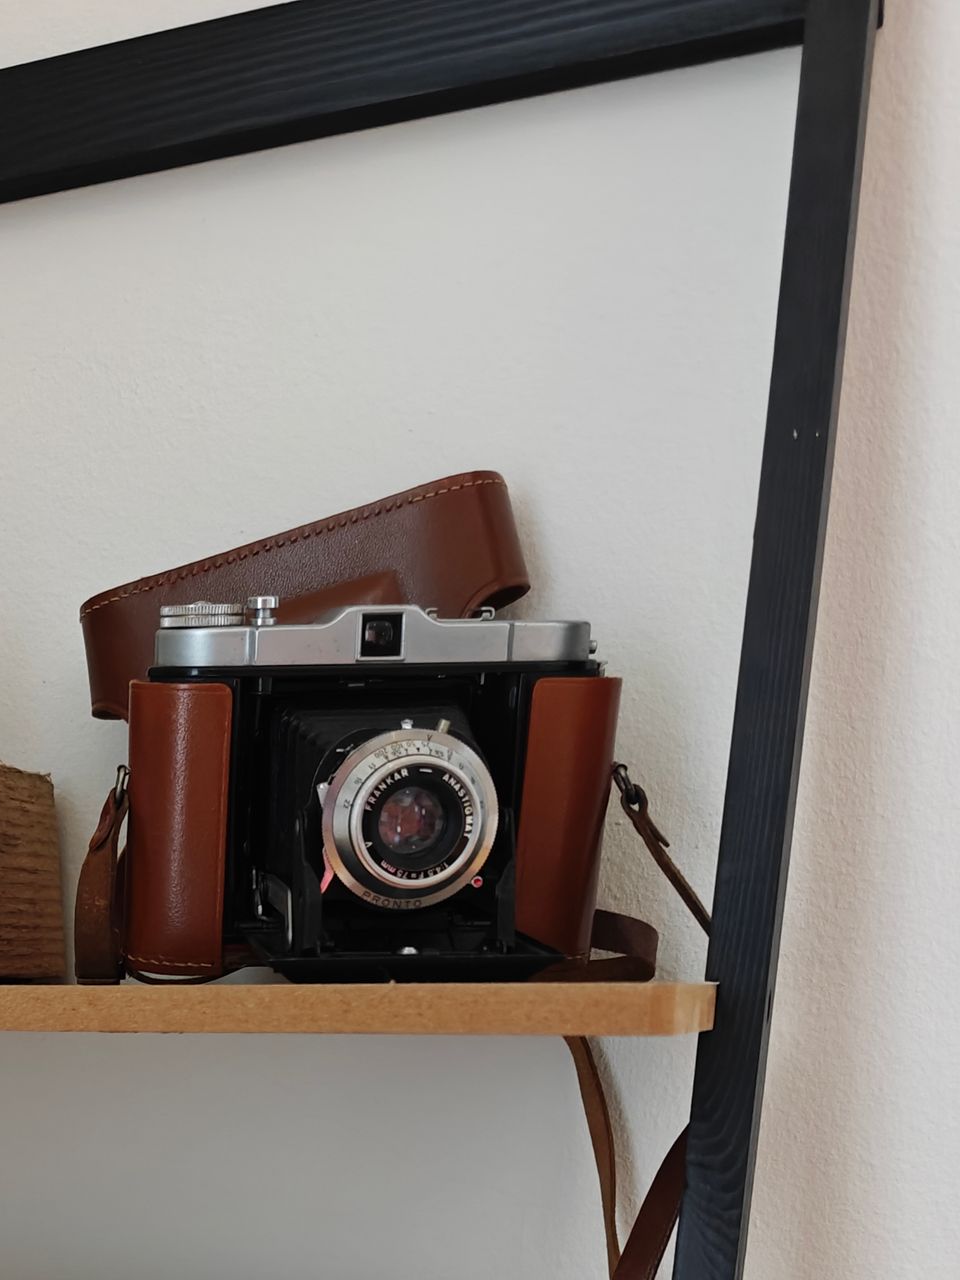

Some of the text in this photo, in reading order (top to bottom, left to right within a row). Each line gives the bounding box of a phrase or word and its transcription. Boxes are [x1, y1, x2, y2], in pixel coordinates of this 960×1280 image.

[365, 768, 474, 839] FRANKAR ANASTIGMAT
[361, 890, 423, 909] PRONTO
